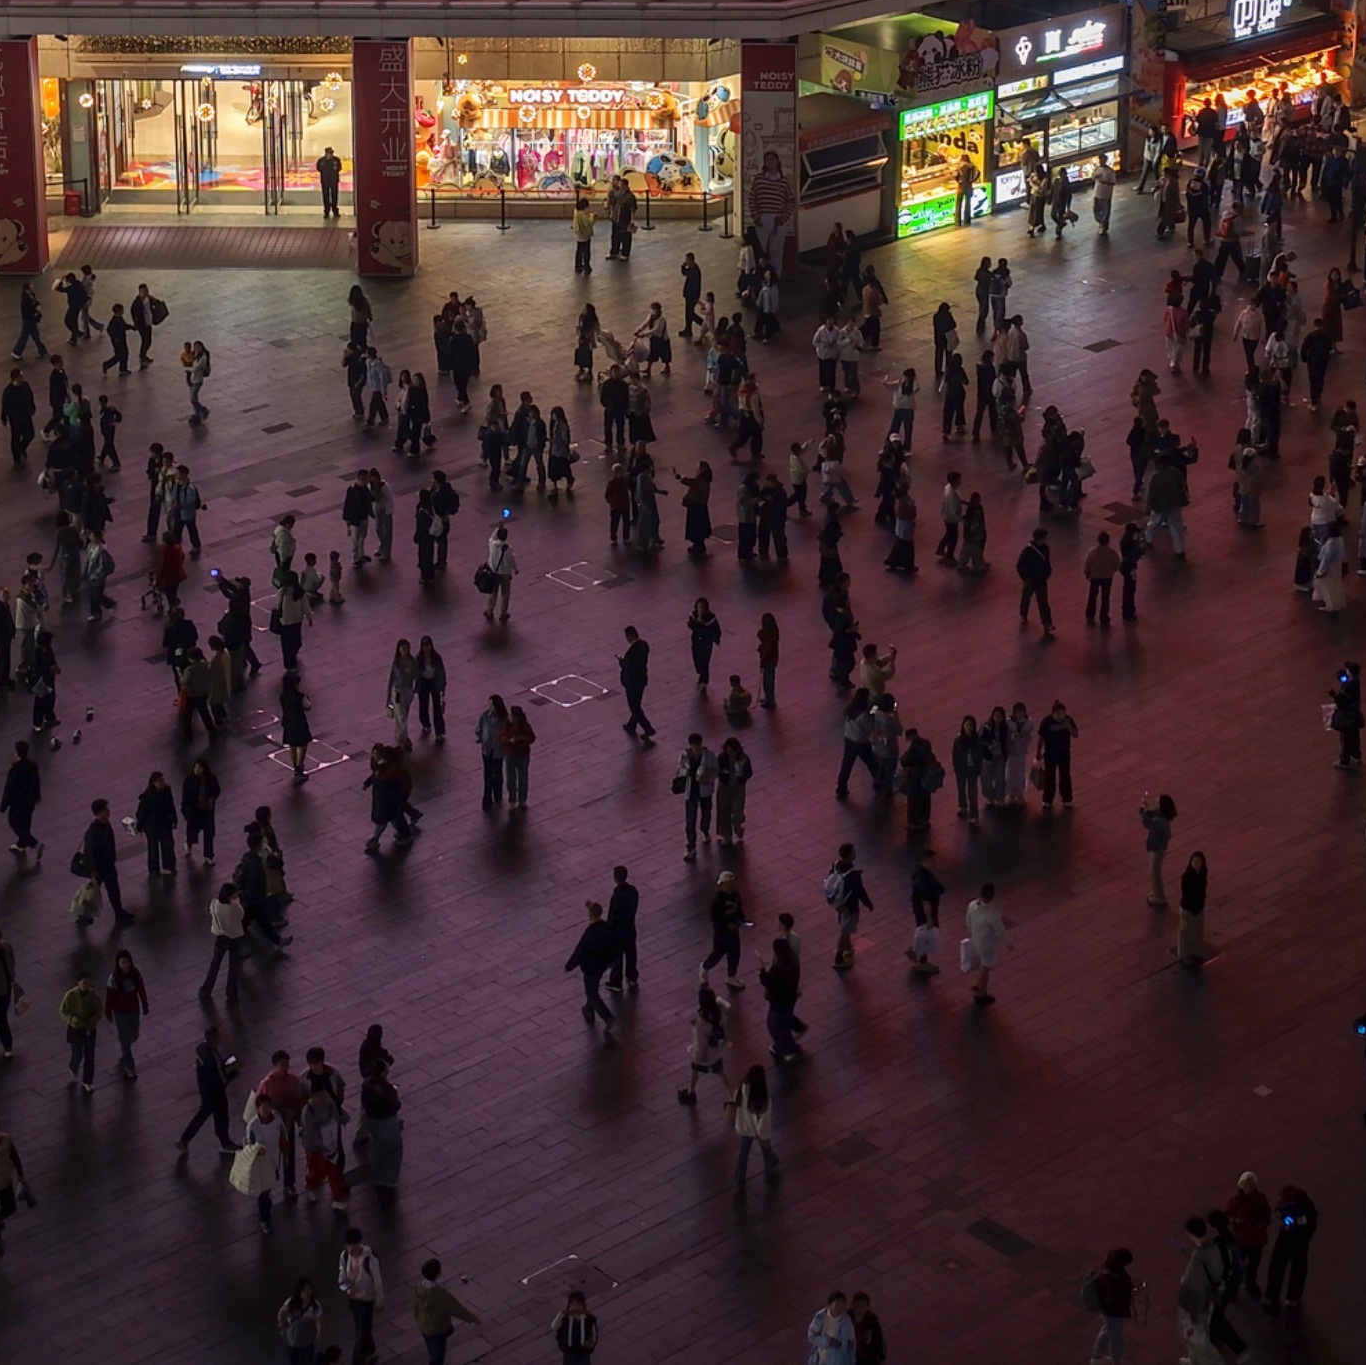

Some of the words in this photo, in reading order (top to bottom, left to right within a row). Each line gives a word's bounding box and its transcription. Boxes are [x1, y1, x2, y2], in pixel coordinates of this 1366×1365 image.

[760, 72, 794, 80] NOISY
[753, 81, 790, 89] TEDDY
[509, 88, 564, 103] NOISY
[567, 88, 625, 103] TEDDY
[378, 47, 408, 163] 盛大开业
